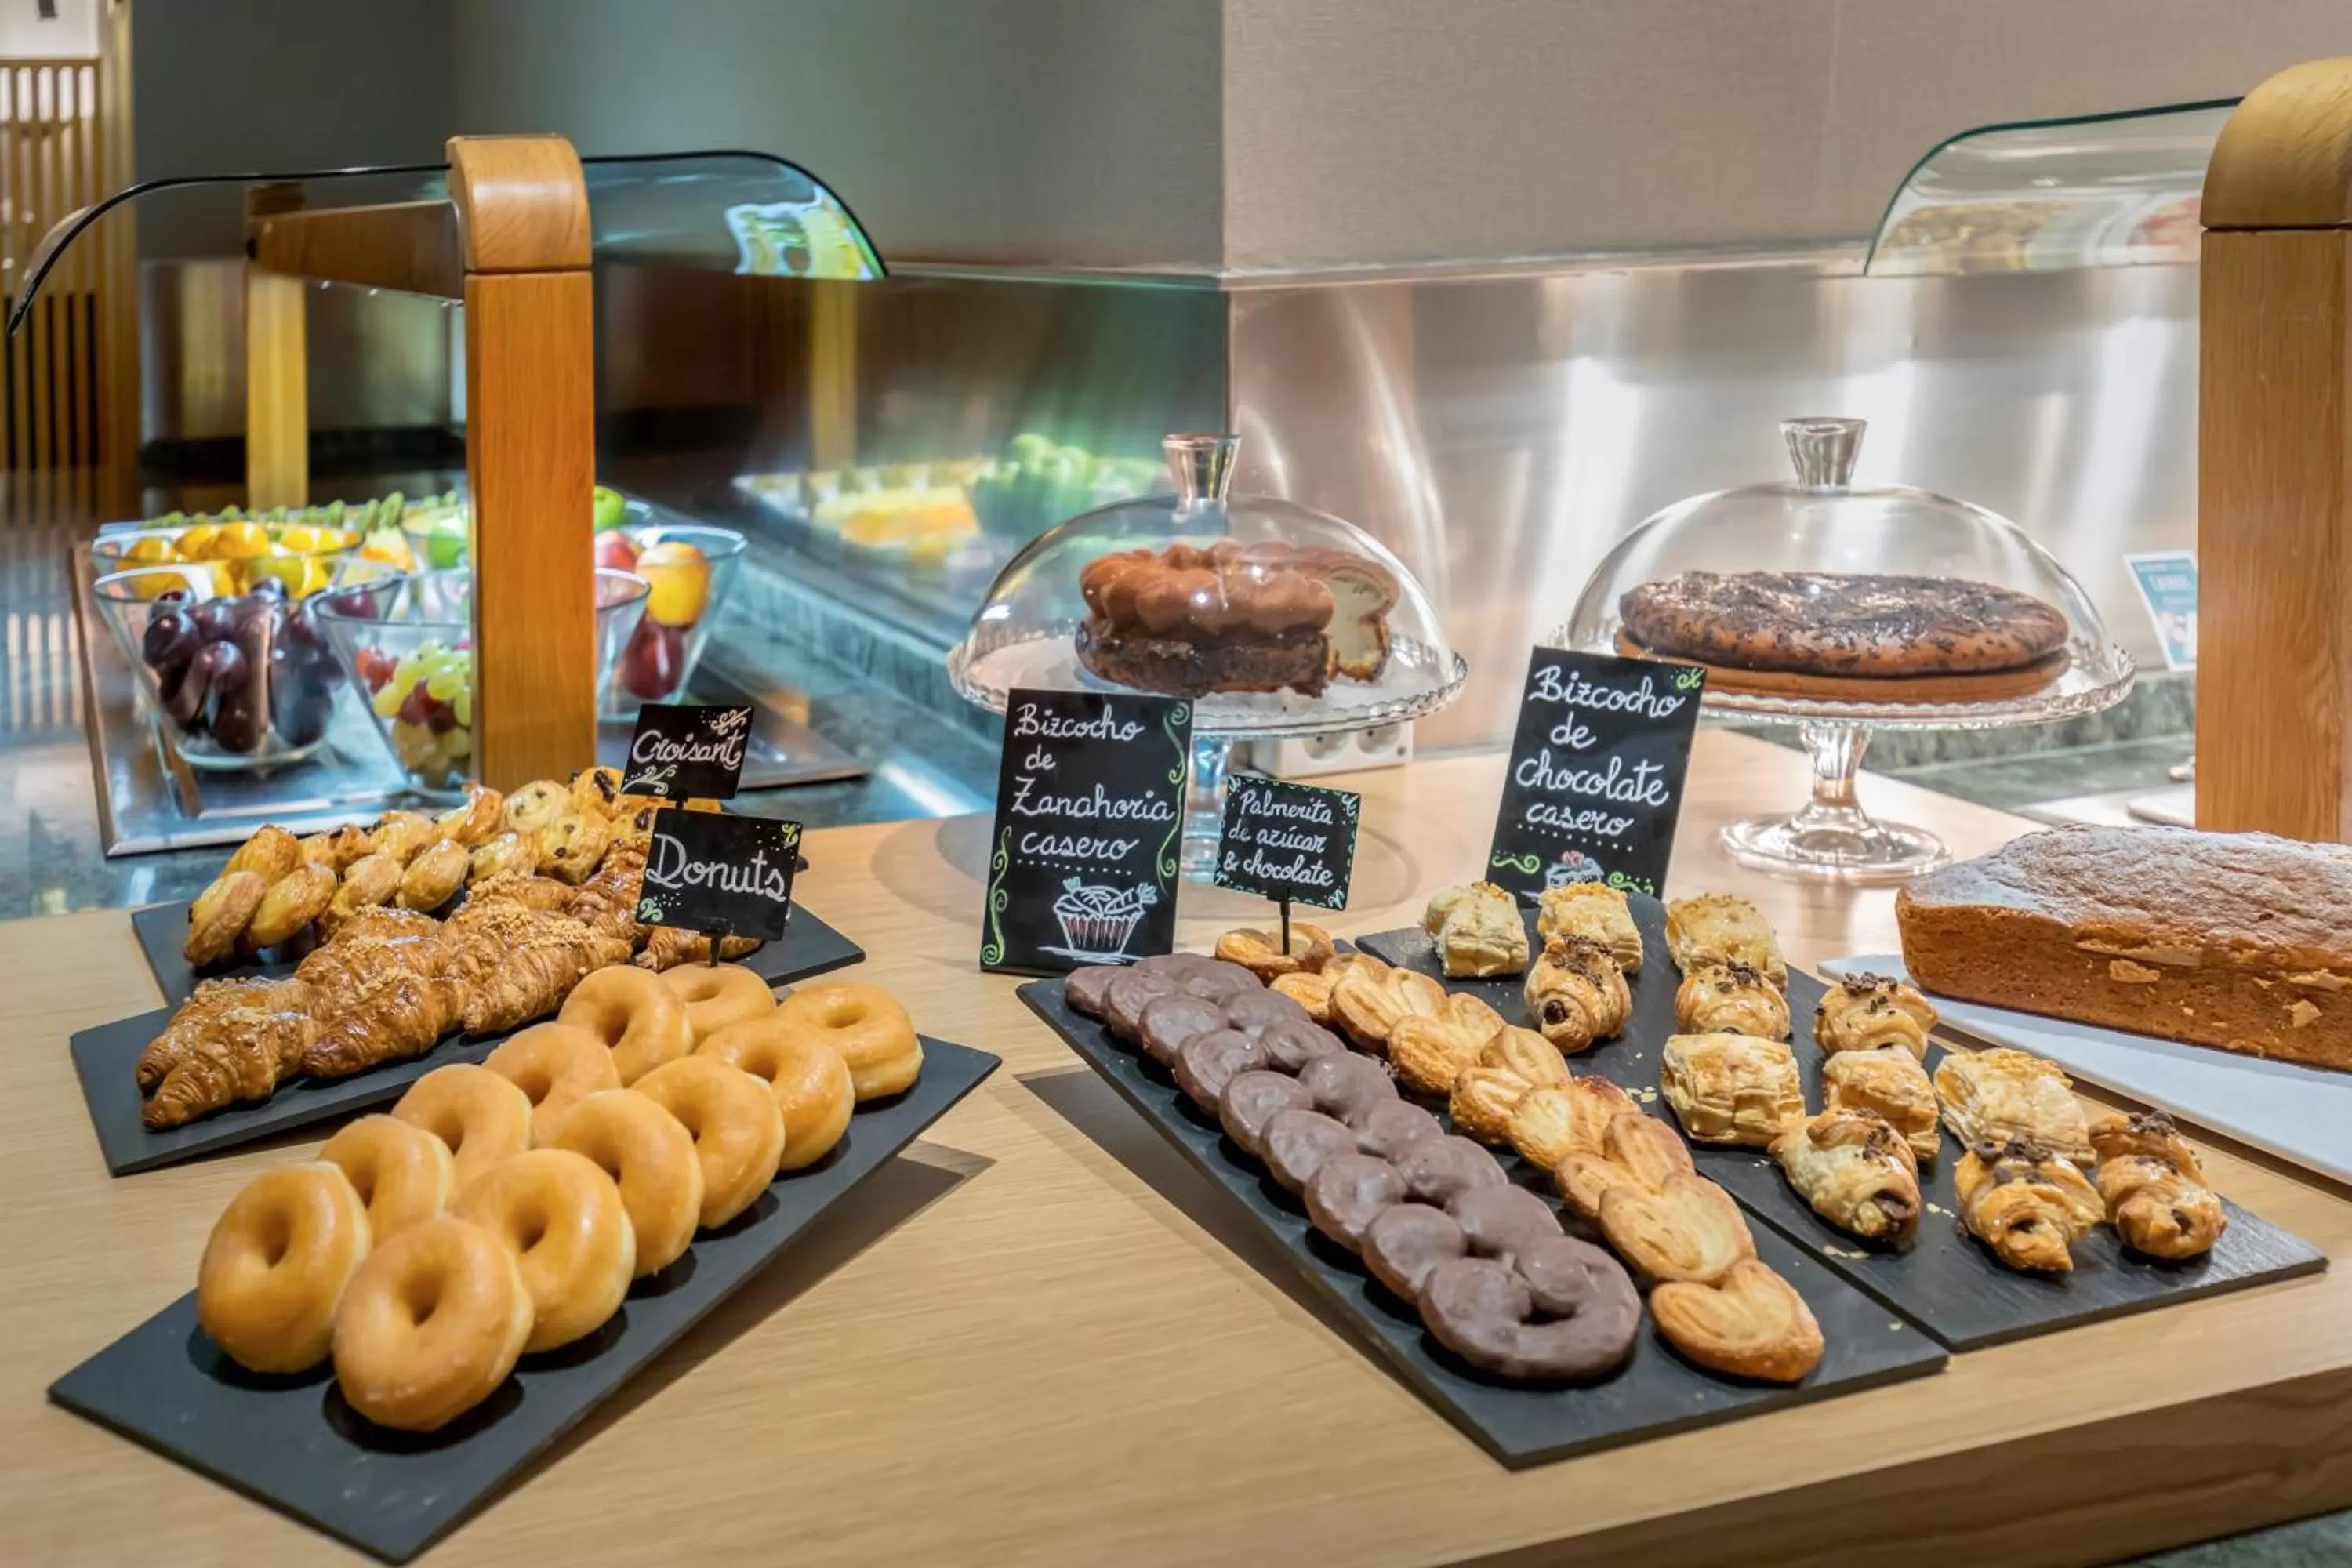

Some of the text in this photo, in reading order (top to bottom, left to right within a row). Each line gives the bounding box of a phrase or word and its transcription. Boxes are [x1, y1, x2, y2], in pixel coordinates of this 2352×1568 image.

[1529, 666, 1686, 718] Bizcocho
[1014, 703, 1145, 741] Bizcocho
[1549, 711, 1597, 749] de
[632, 729, 746, 771] Croisant
[1025, 744, 1057, 771] de
[1011, 775, 1176, 821] Zanahoria
[1240, 789, 1334, 825] Palmerita
[1229, 819, 1327, 854] de azúcar
[1526, 803, 1635, 836] casero
[1020, 831, 1140, 860] casero
[645, 833, 786, 902] Donuts
[1223, 848, 1334, 887] & chocolate
